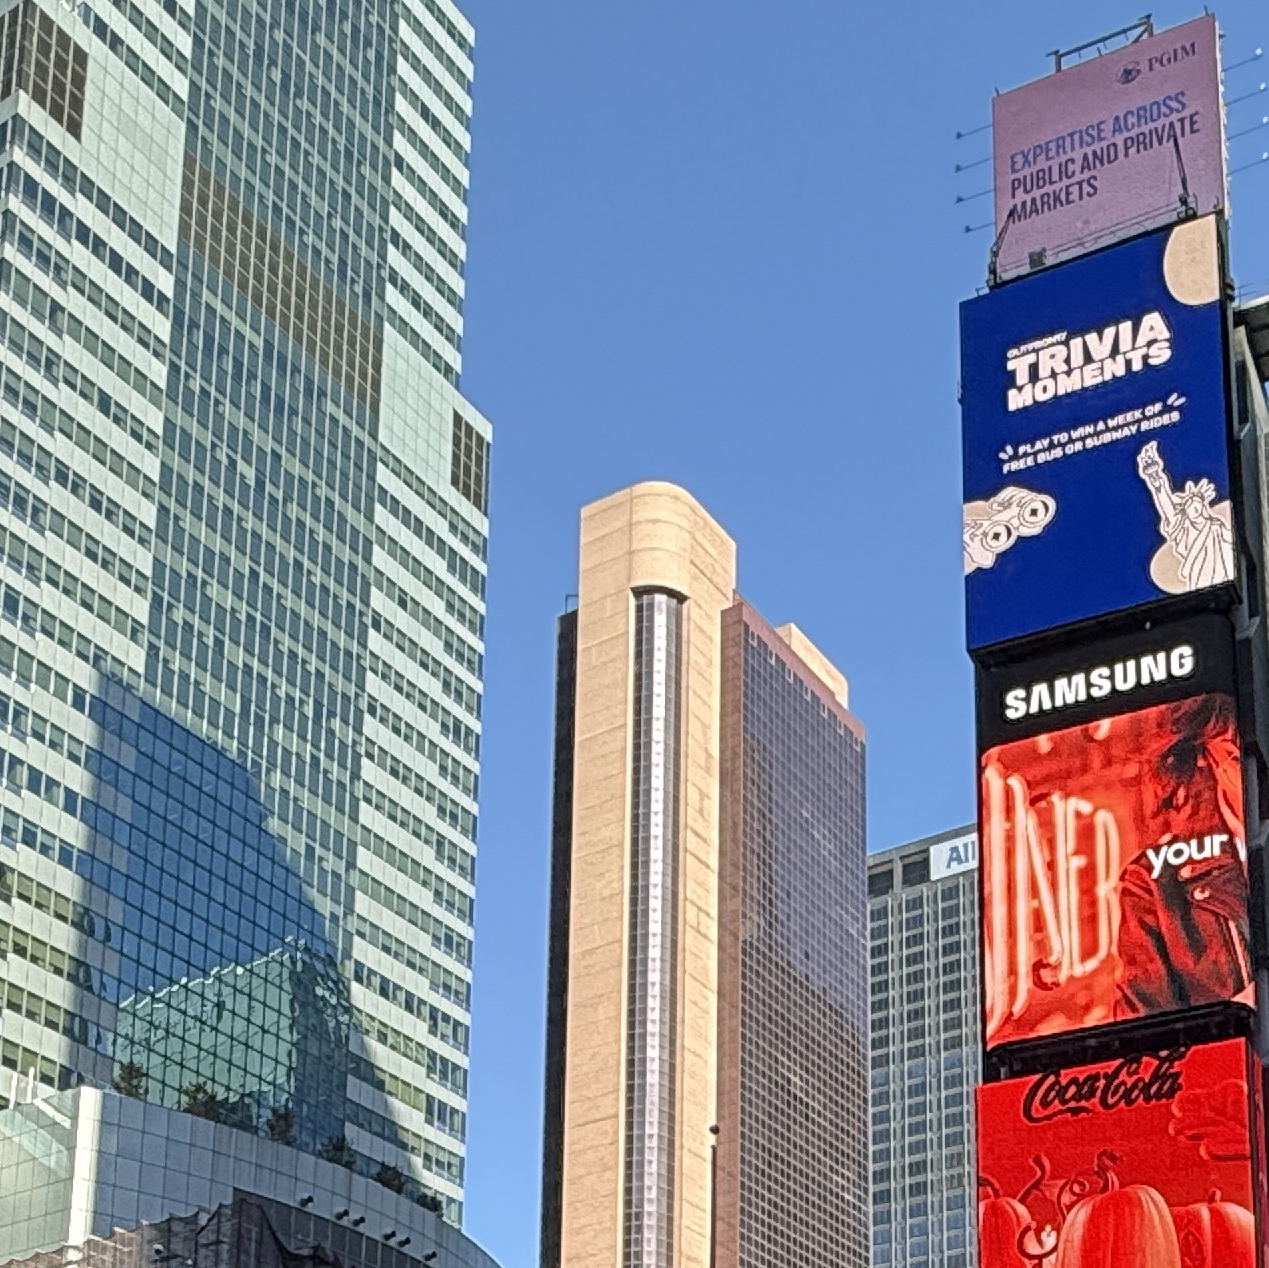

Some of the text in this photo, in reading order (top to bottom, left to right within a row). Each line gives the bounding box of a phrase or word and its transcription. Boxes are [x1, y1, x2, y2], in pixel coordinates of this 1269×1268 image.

[1146, 41, 1197, 72] PGIM
[1009, 90, 1188, 175] EXPERTISE ACROSS
[1011, 110, 1201, 200] PUBLIC AND PRIVATE
[1011, 175, 1099, 225] MARKETS
[1006, 310, 1171, 387] TRIVIA
[1007, 340, 1172, 412] MOMENTS
[1002, 410, 1181, 475] FREE BUS OR SUBWAY RIDES
[1018, 402, 1164, 456] PLAY TO WIN A WEEK OF
[1002, 644, 1196, 721] SAMSUNG
[1146, 833, 1229, 881] your
